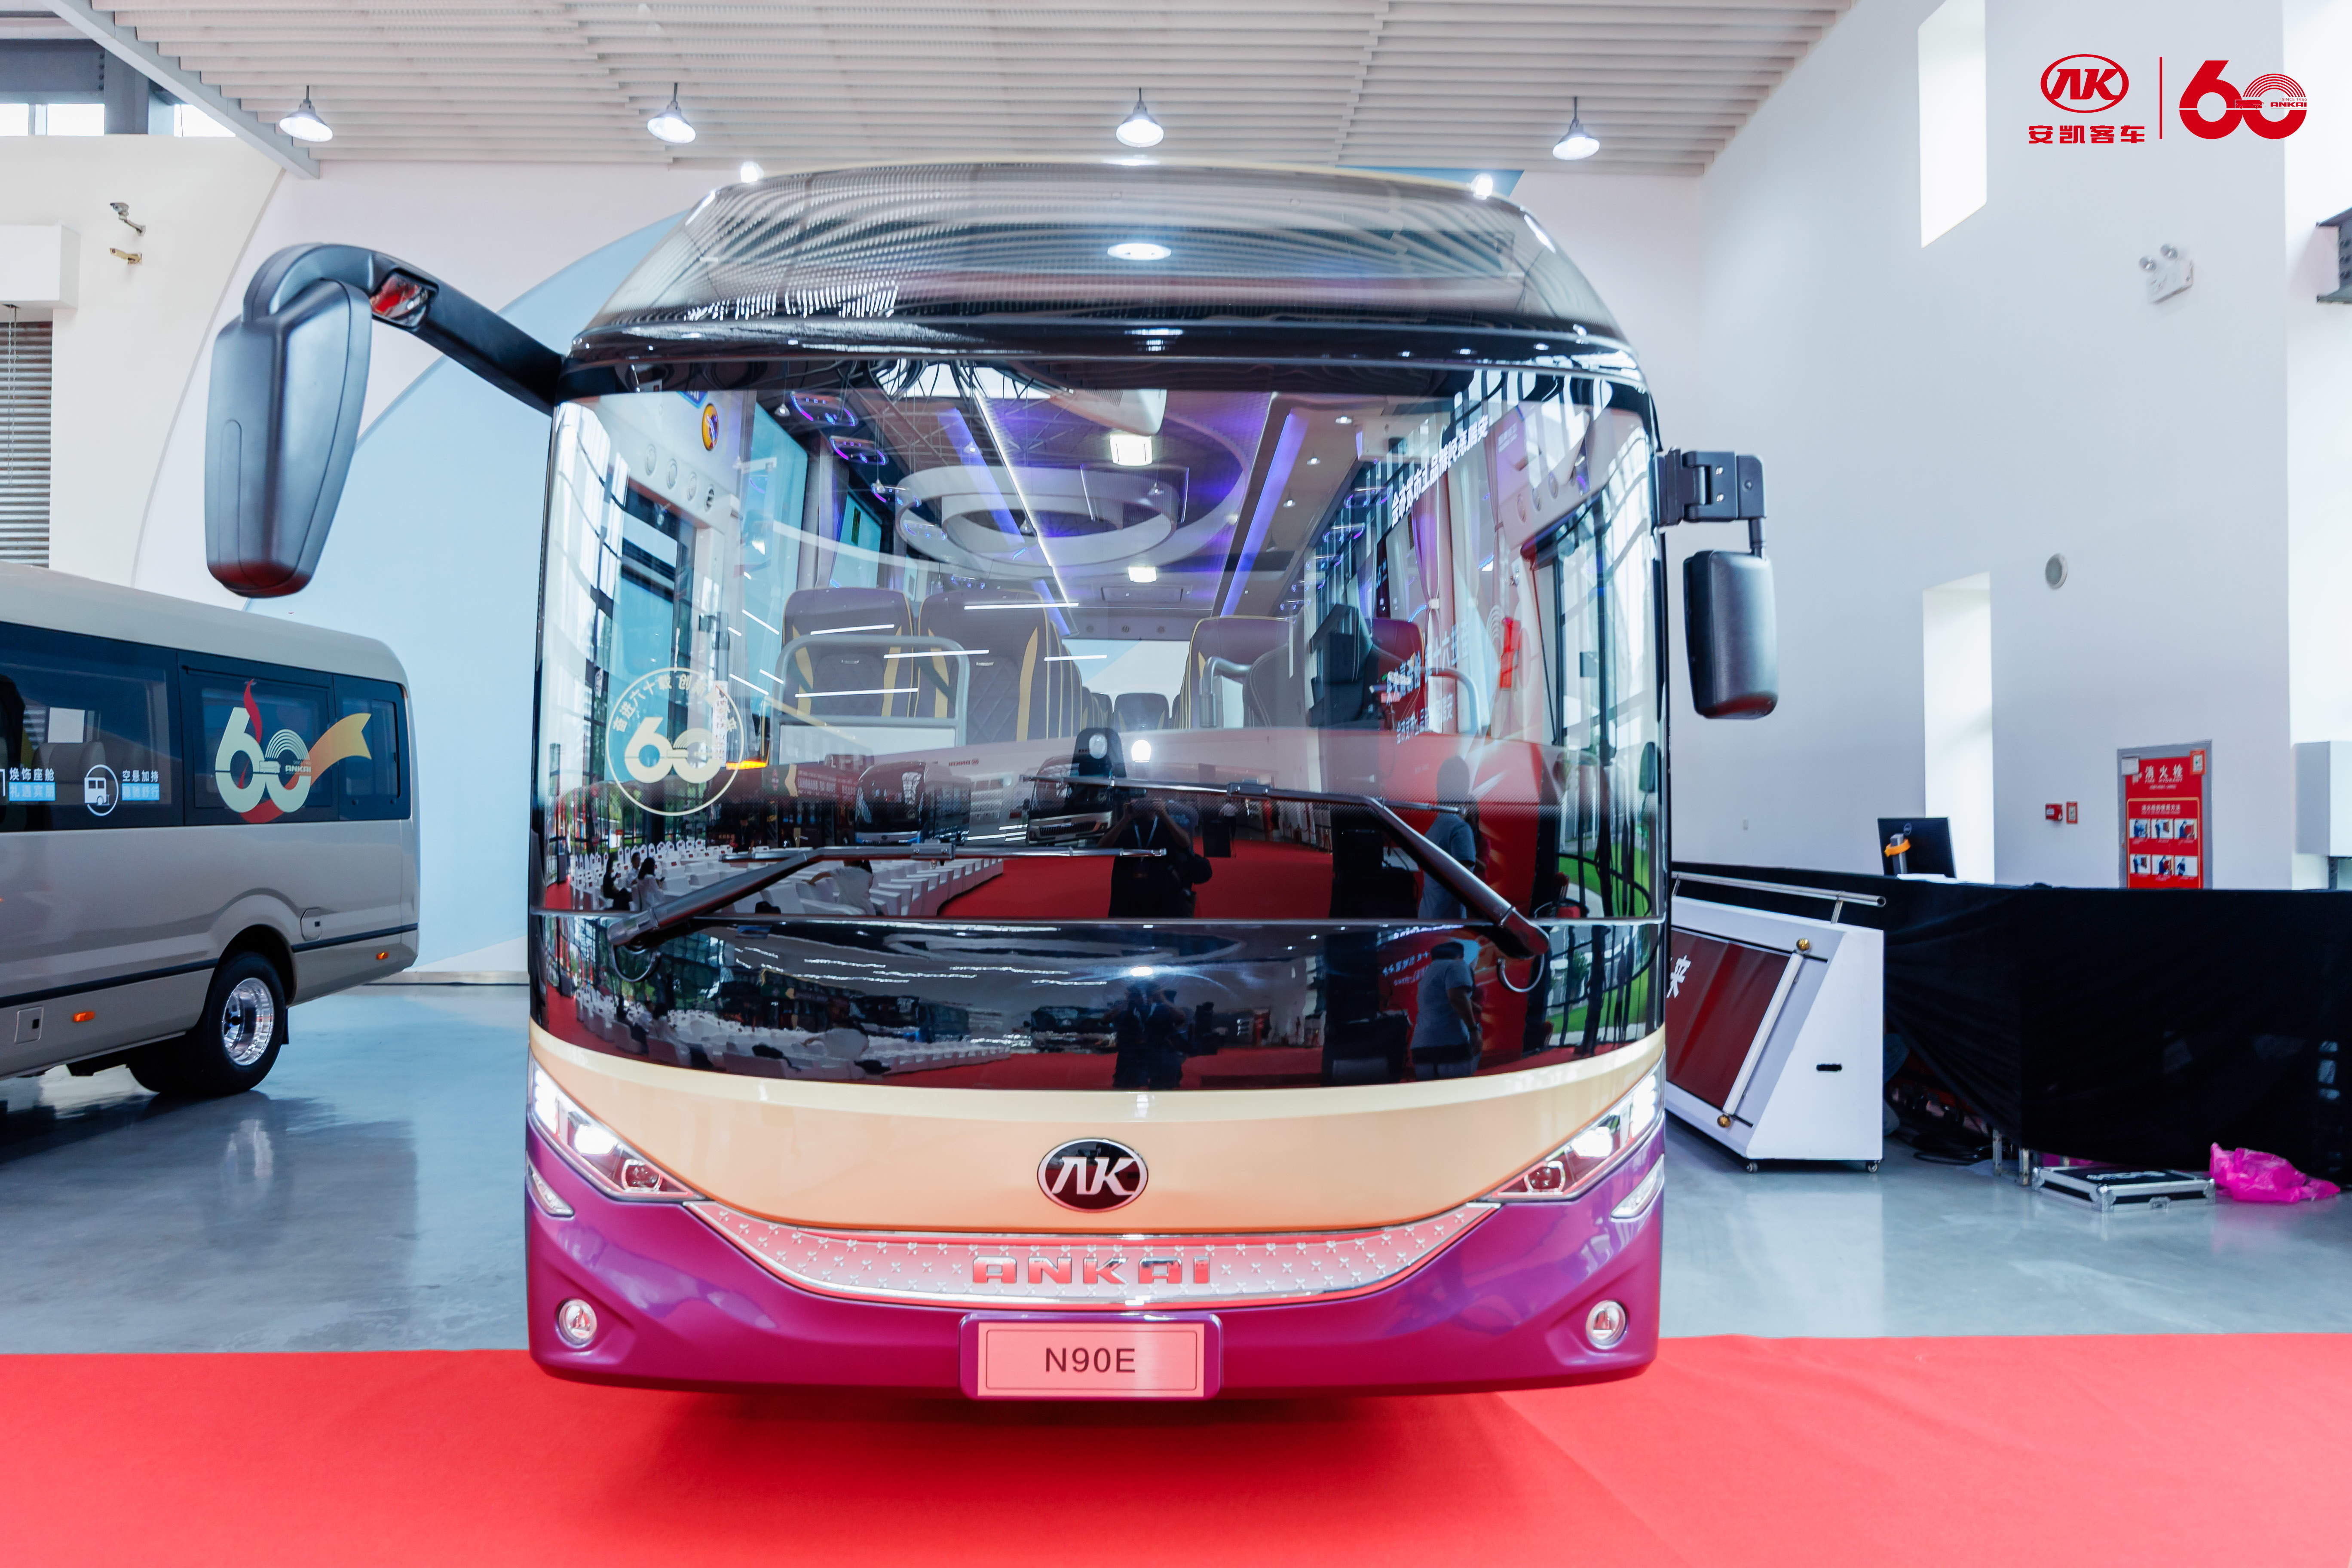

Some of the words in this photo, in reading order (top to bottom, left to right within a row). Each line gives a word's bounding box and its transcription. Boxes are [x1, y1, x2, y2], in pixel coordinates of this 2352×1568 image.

[215, 707, 312, 813] 60
[625, 717, 722, 784] 60
[9, 767, 55, 781] 焕饰座舱
[122, 769, 159, 783] 空悬加持
[285, 765, 312, 773] ANKAI
[2145, 764, 2183, 779] 消火栓
[972, 1256, 1210, 1284] ANKAI
[1045, 1347, 1136, 1373] N90E
